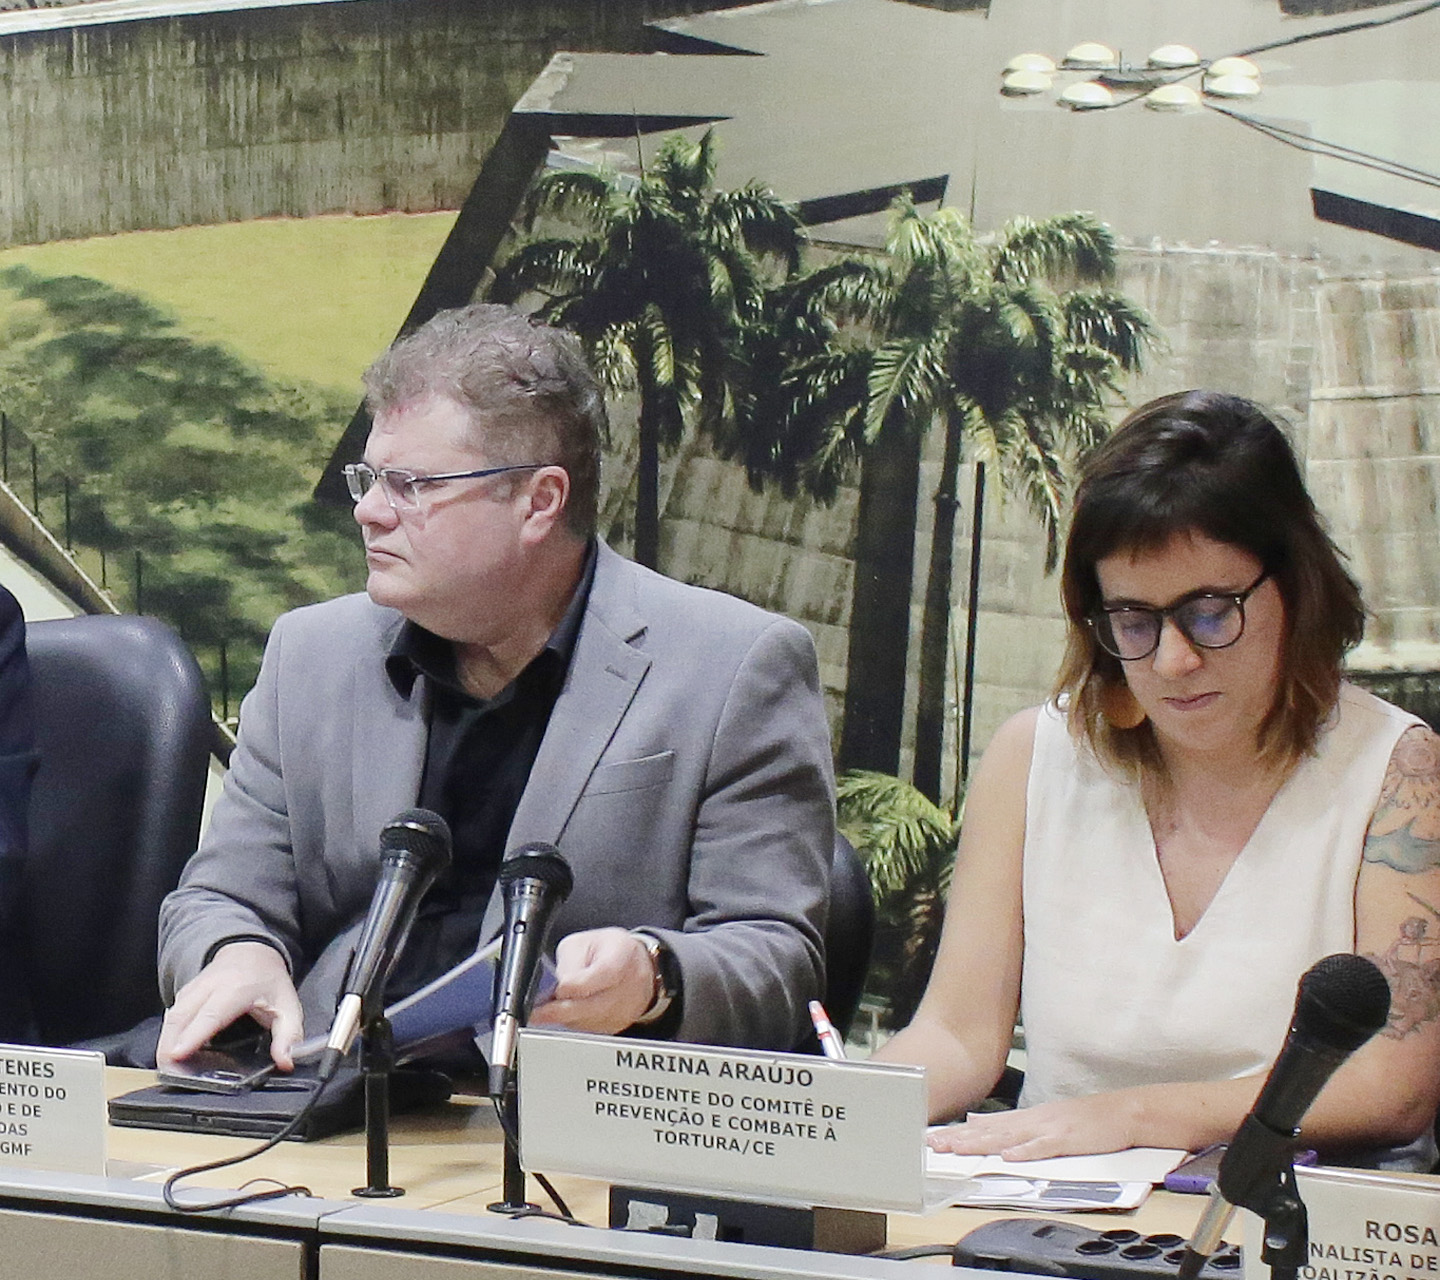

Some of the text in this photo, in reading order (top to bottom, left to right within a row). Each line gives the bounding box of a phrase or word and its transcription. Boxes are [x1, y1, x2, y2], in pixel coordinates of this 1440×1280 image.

[616, 1050, 814, 1087] MARINA ARAÚJO
[44, 1086, 66, 1100] DO
[586, 1079, 846, 1120] PRESIDENTE DO COMITÊ DE
[8, 1103, 16, 1115] E
[22, 1104, 42, 1118] DE
[595, 1101, 837, 1141] PREVENÇÃO E COMBATE À
[653, 1129, 775, 1156] TORTURA/CE
[1365, 1220, 1438, 1247] ROSA
[1309, 1243, 1402, 1268] NALISTA
[1411, 1254, 1438, 1272] DE
